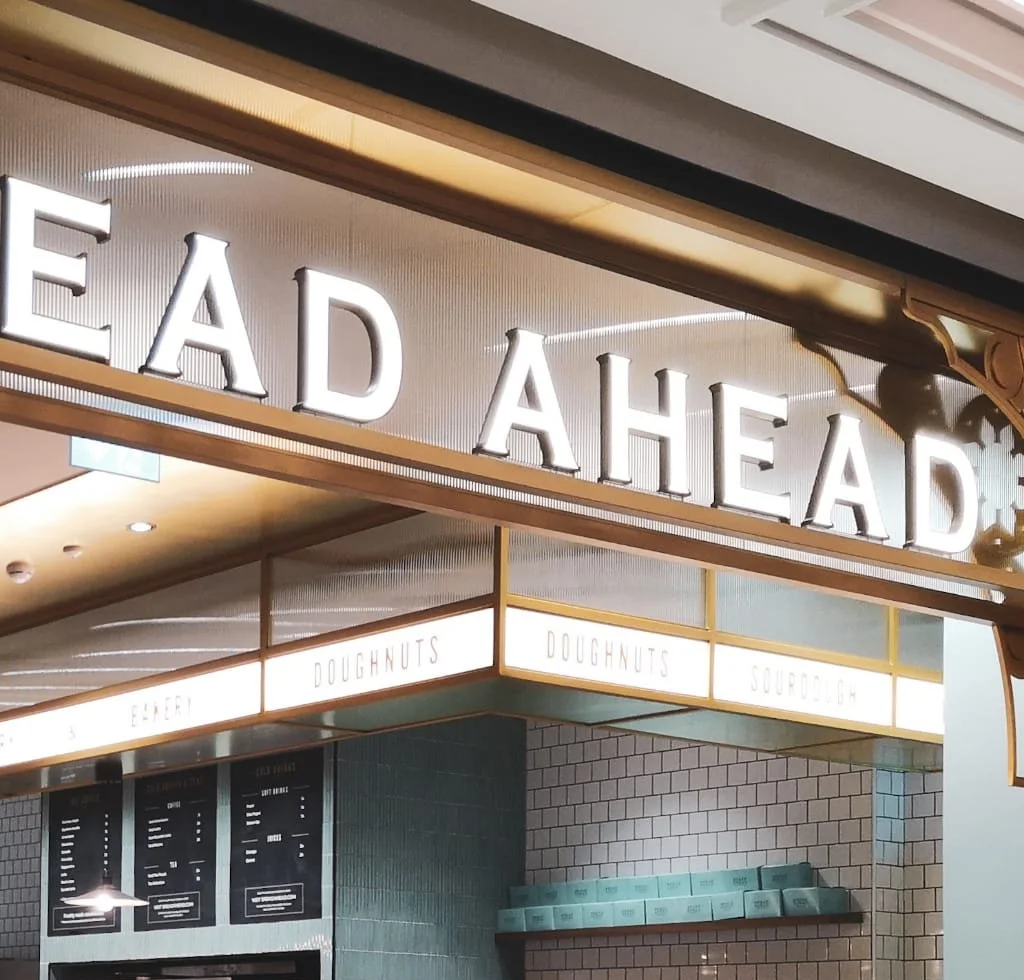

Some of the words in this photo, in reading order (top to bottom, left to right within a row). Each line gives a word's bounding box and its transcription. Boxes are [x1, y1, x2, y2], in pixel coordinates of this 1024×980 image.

[472, 327, 977, 555] AHEAD
[314, 634, 441, 689] DOUGHNUTS
[547, 629, 670, 679] DOUGHNUTS
[751, 665, 857, 707] SOURDOUGH
